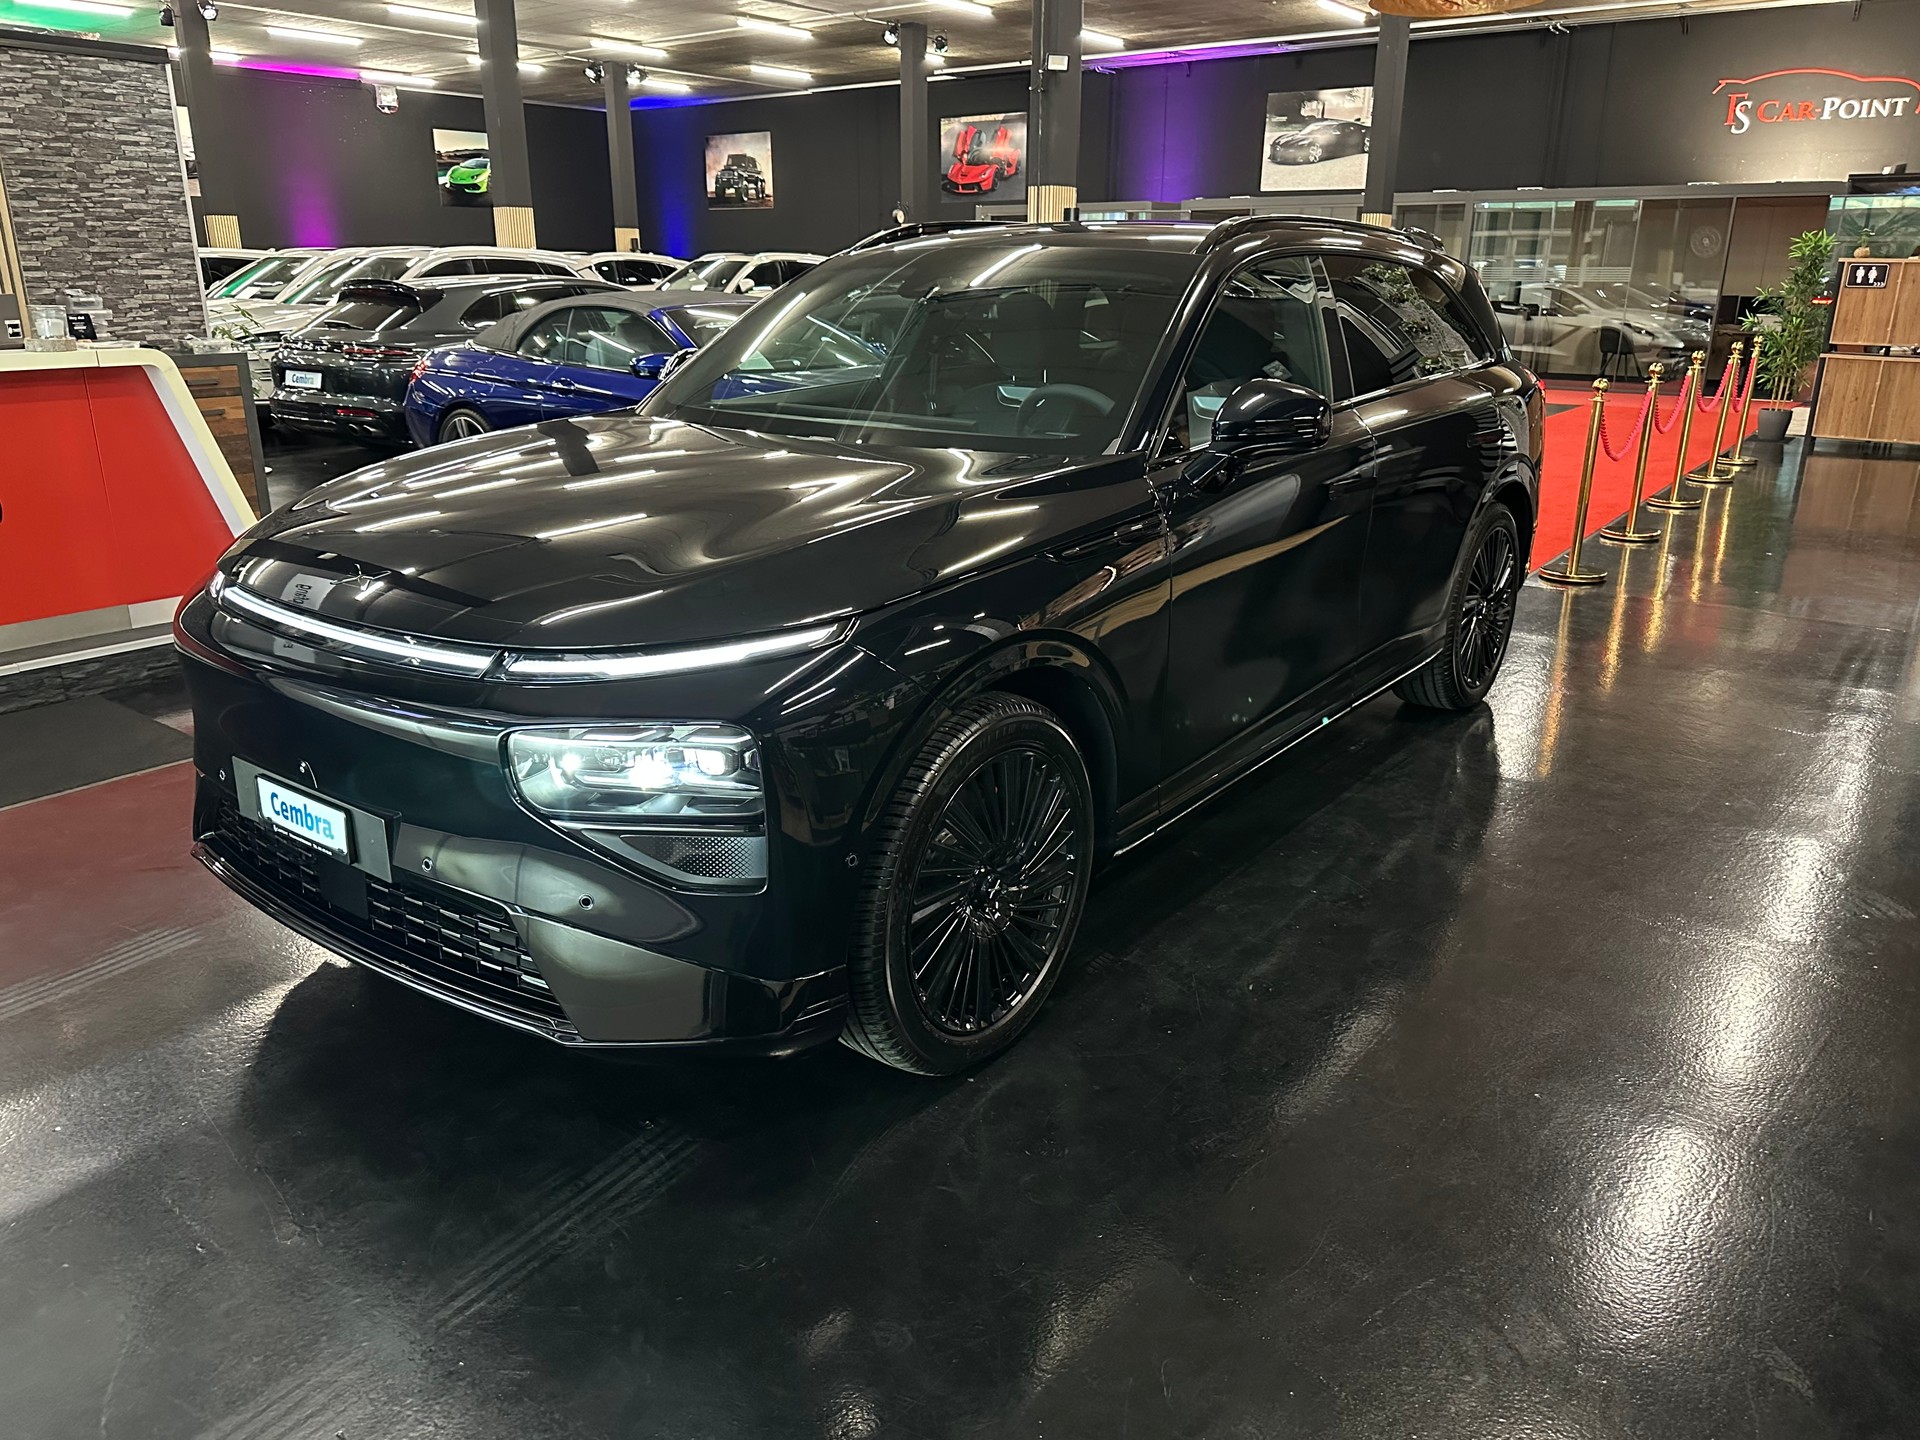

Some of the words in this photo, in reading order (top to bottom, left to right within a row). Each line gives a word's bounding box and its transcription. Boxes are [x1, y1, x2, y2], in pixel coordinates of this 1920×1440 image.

[1757, 96, 1911, 123] CAR-POINT
[291, 373, 315, 385] Cembra
[270, 791, 335, 840] Cembra
